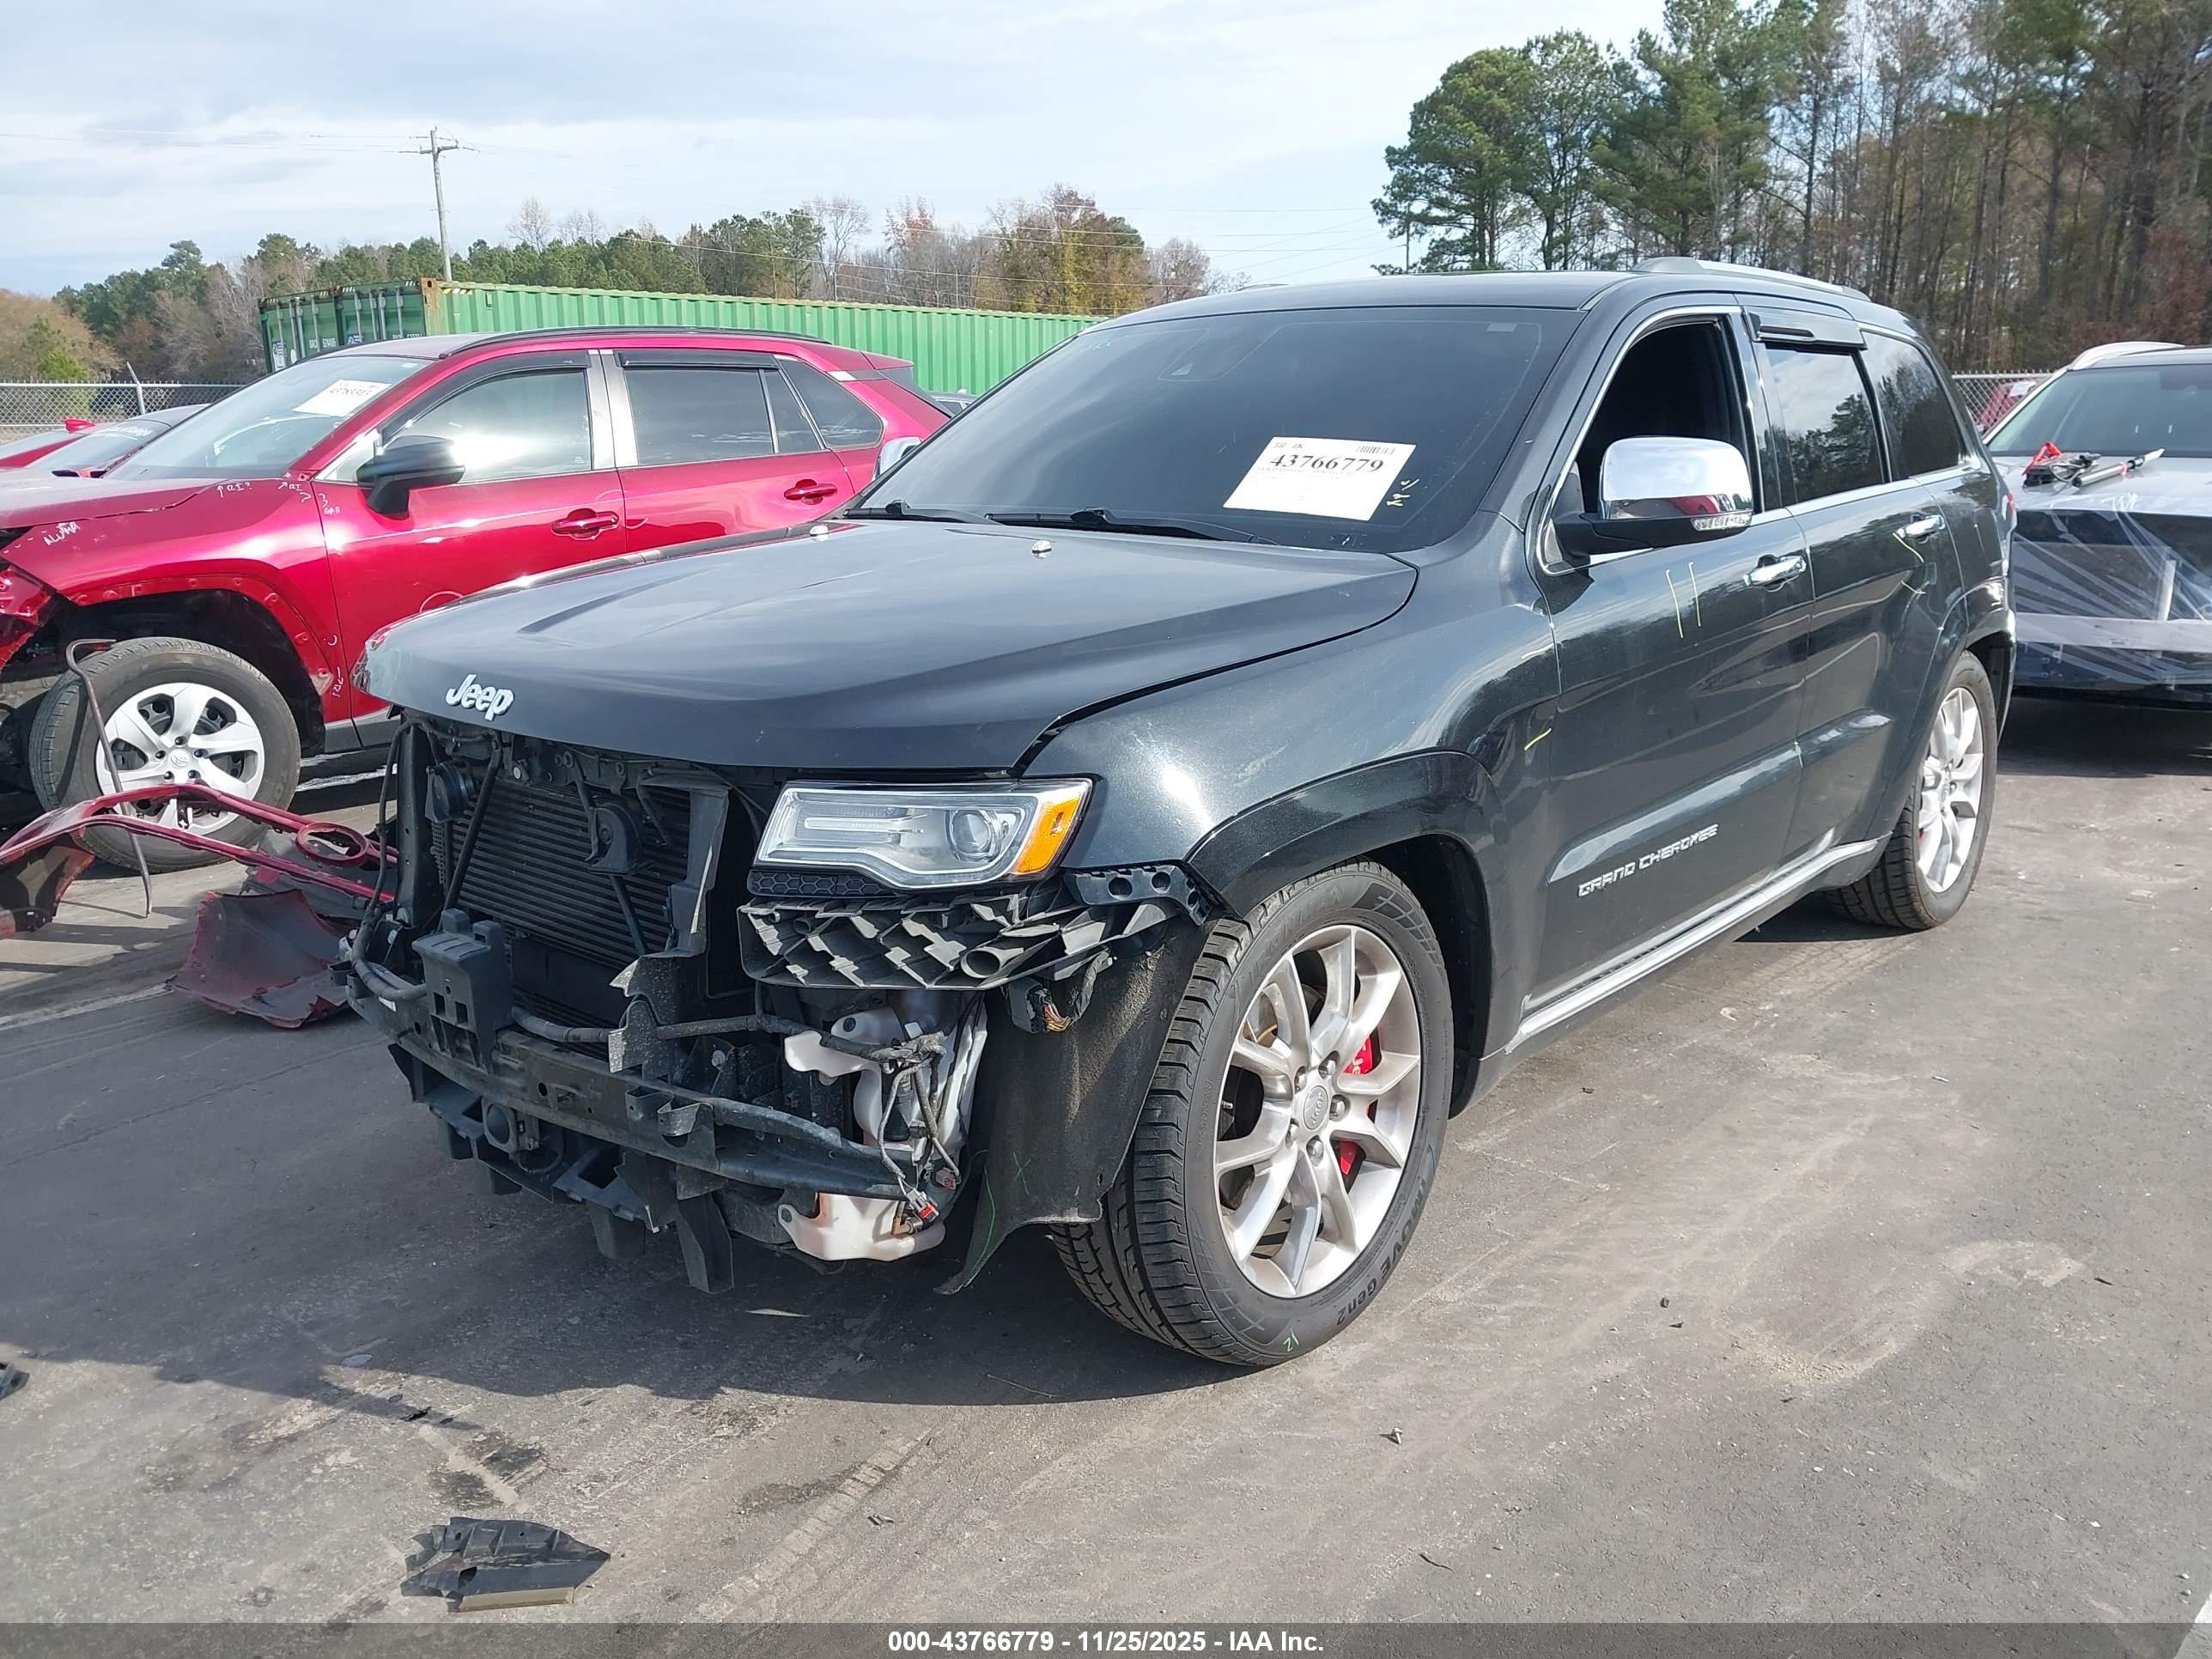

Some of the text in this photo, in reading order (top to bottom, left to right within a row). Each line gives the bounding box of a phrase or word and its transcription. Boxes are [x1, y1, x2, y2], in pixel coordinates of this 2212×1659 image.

[1271, 454, 1384, 472] 43766779
[445, 673, 515, 722] Jeep
[1577, 823, 1718, 897] GRAND CHEROKEE
